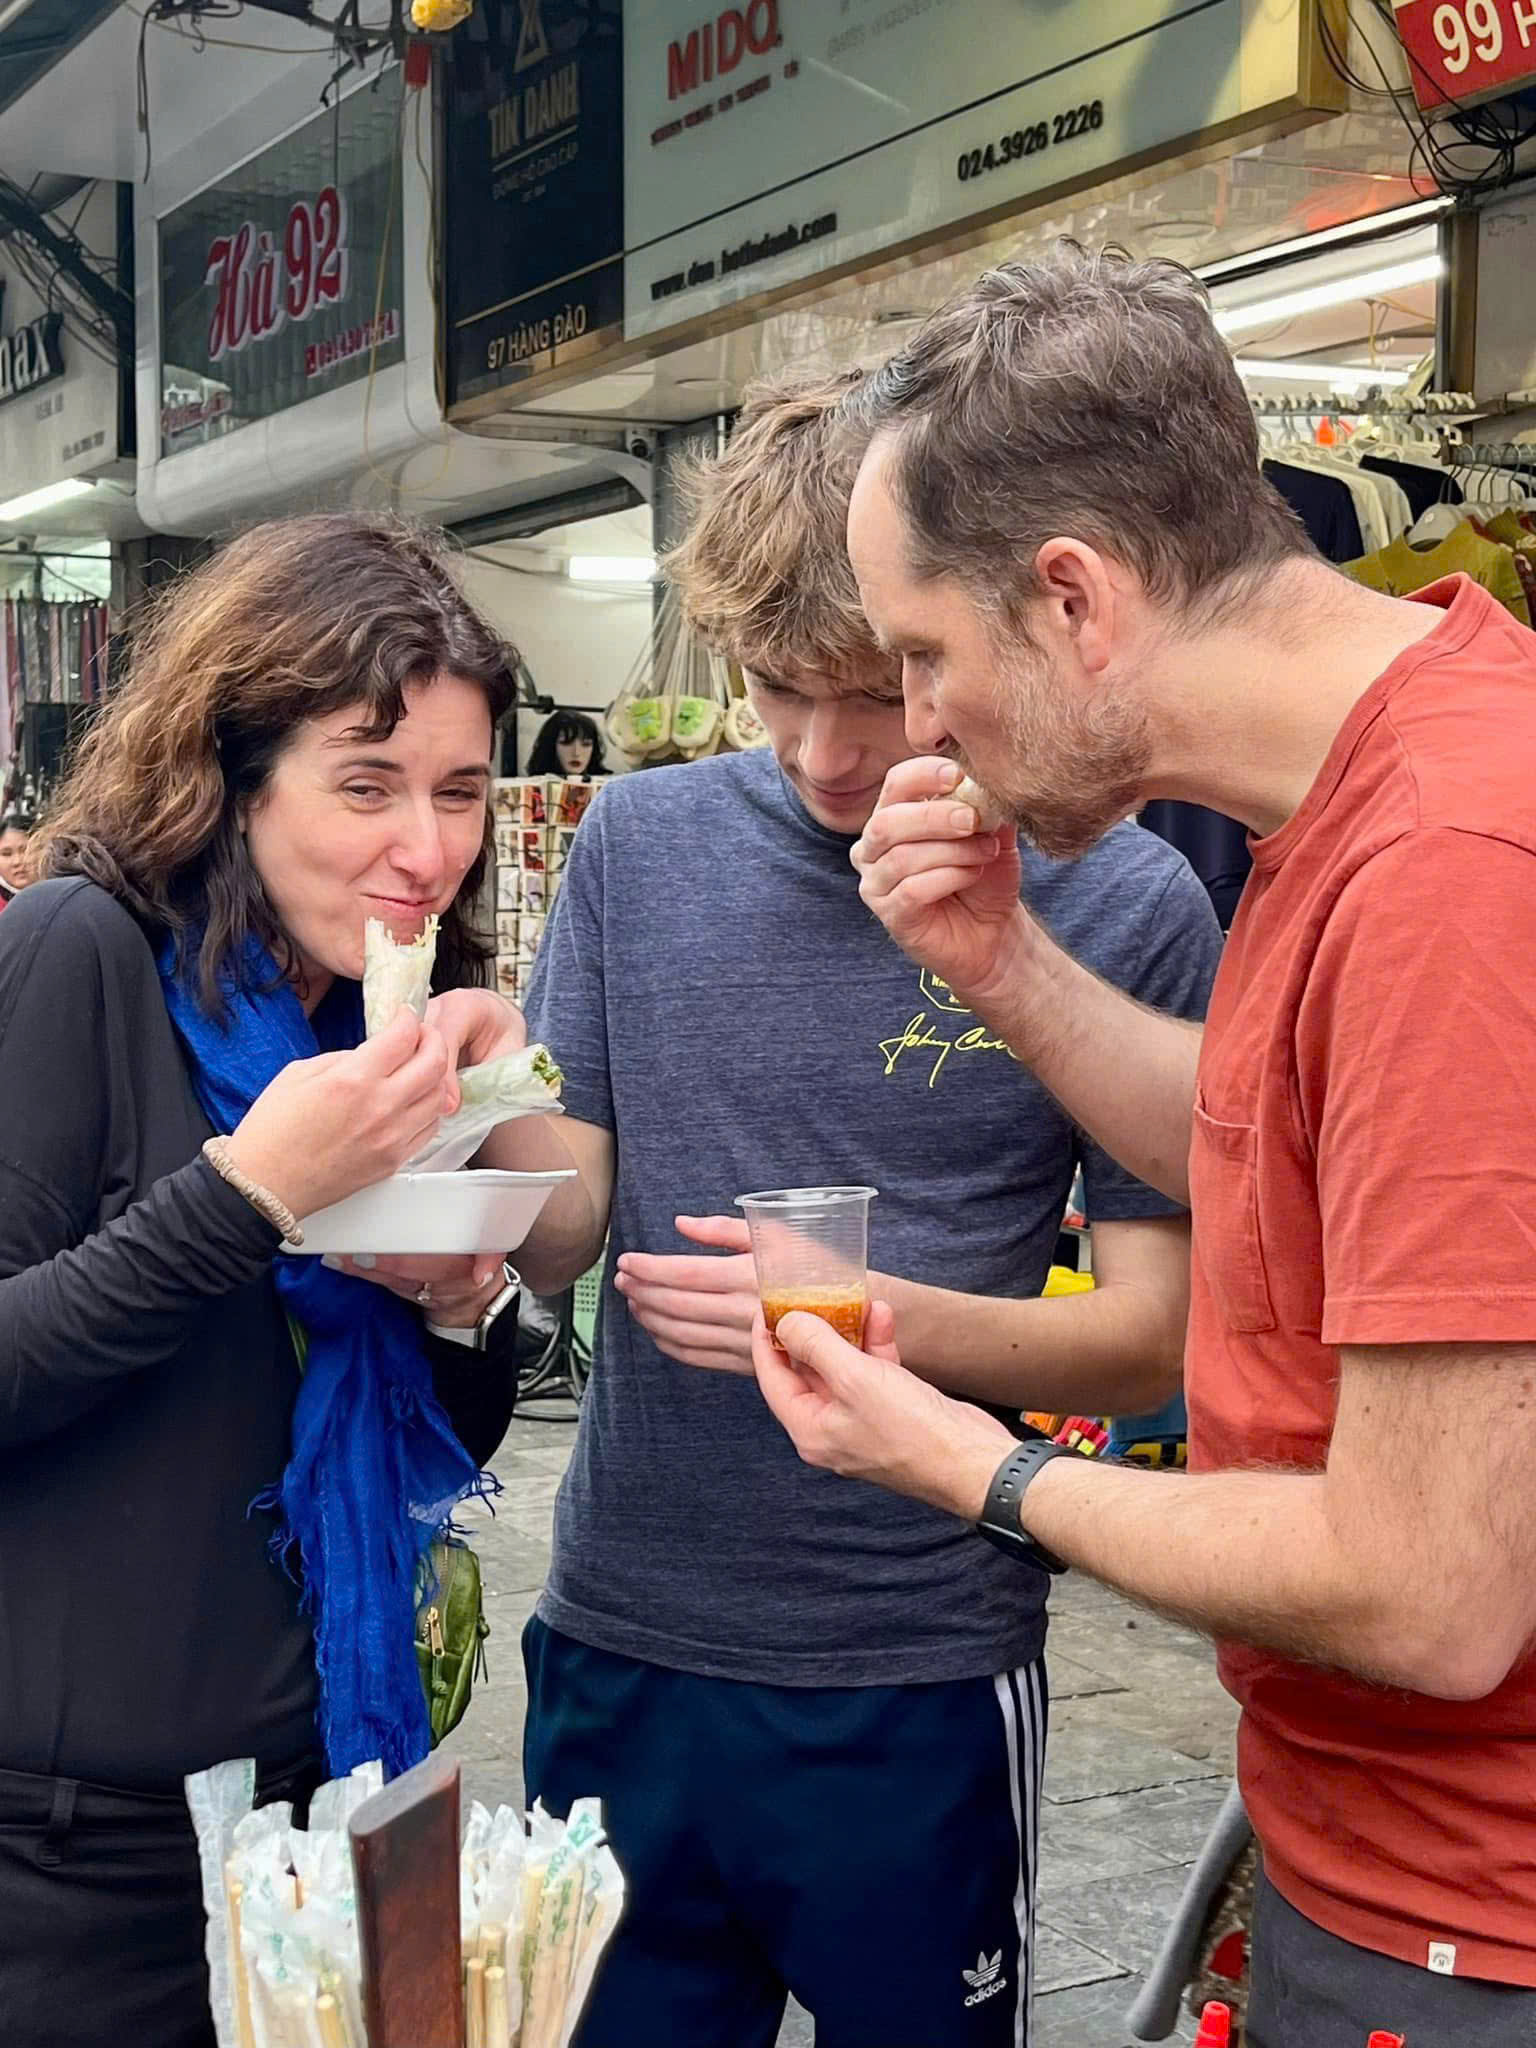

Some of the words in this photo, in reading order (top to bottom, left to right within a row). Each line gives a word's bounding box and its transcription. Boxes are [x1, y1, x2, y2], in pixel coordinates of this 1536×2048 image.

[668, 0, 778, 101] MIDO
[1433, 0, 1503, 74] 99
[525, 61, 579, 139] DANH
[957, 121, 1048, 182] 024.3926
[1053, 99, 1104, 144] 2226
[205, 221, 283, 361] Hà
[284, 184, 349, 321] 92
[487, 336, 506, 369] 97
[508, 319, 551, 362] HÀNG
[553, 302, 587, 344] ĐÀO
[963, 1976, 1008, 2007] adidas
